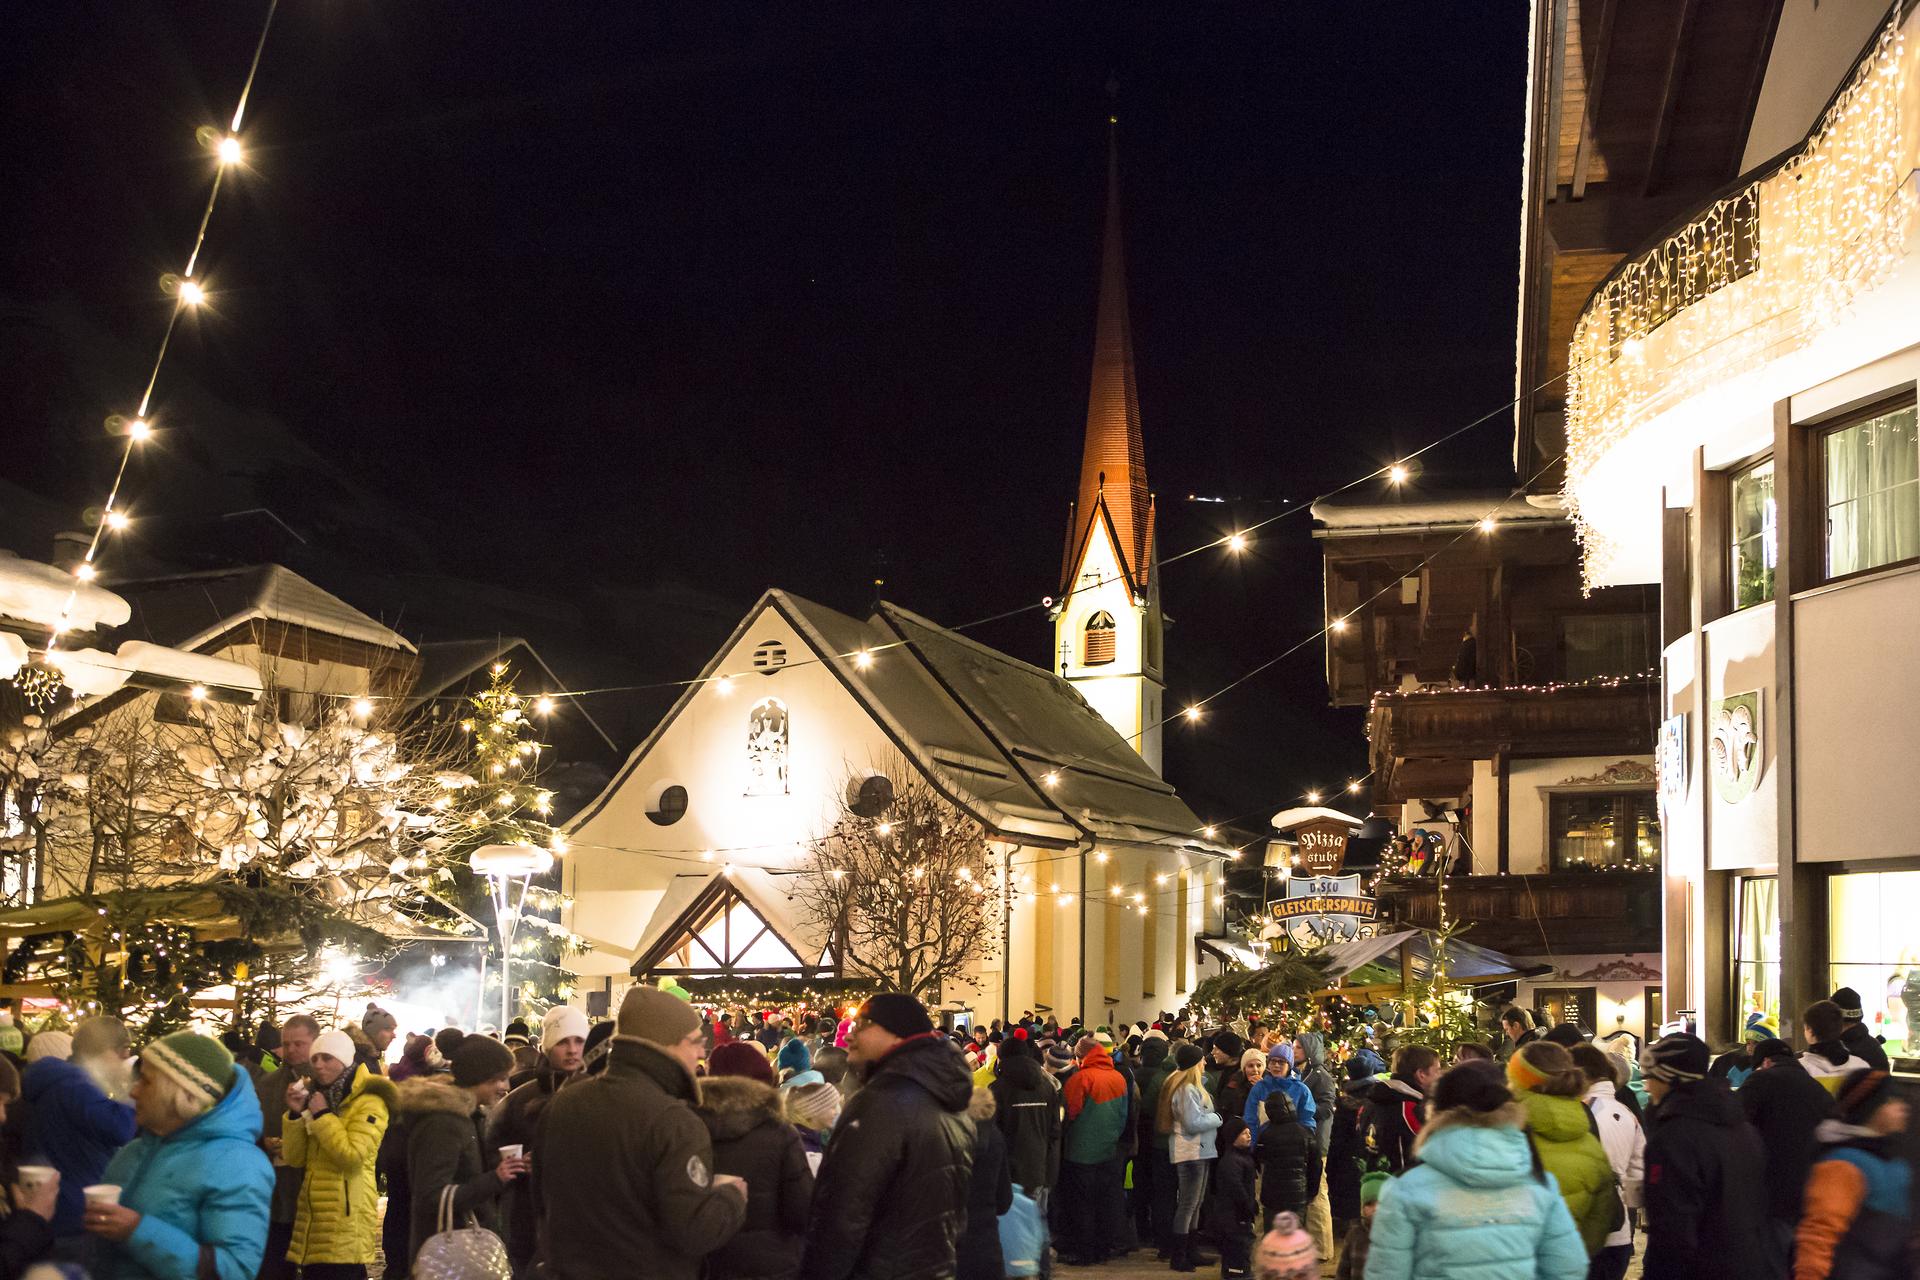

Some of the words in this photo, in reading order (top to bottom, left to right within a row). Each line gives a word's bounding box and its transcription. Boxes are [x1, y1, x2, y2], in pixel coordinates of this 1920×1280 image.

[1301, 831, 1344, 850] Pizza
[1307, 851, 1338, 862] stube
[1273, 899, 1374, 917] GLETSCHERSPALTE
